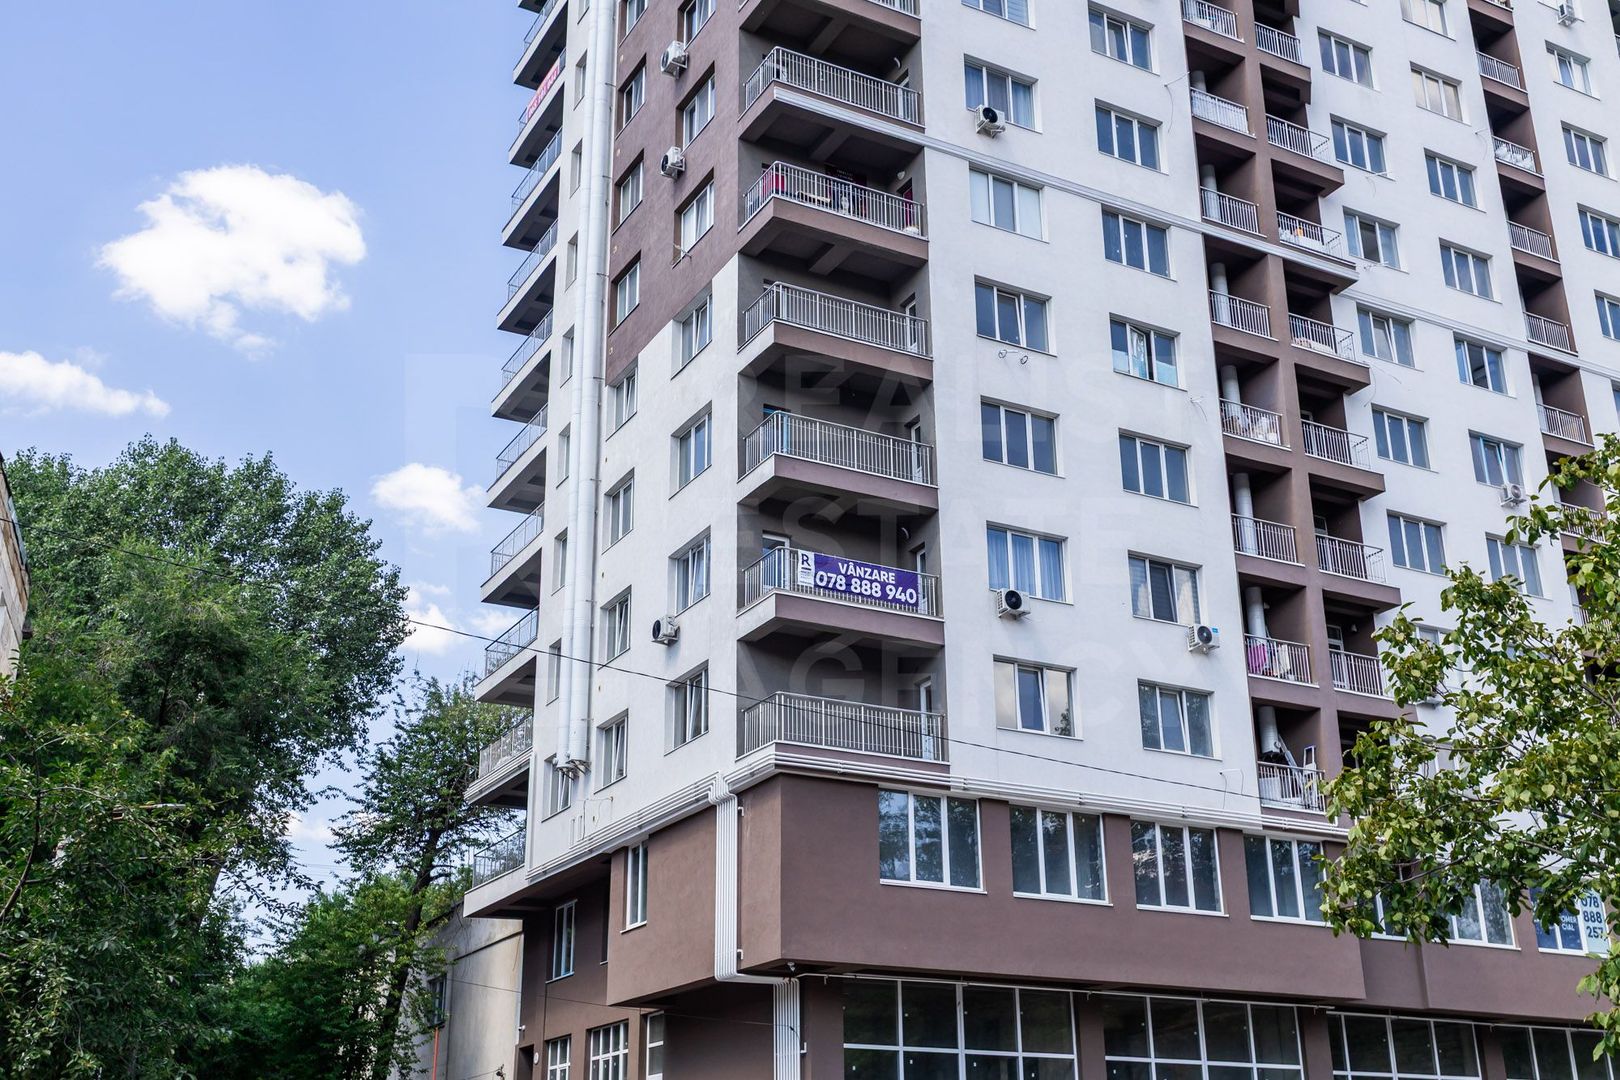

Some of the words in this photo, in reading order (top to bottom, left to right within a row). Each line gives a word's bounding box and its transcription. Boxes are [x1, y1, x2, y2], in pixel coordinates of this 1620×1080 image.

[801, 553, 811, 567] R
[838, 562, 896, 584] VÂNZARE
[815, 571, 847, 591] 078
[850, 578, 882, 598] 888
[885, 585, 917, 604] 940
[1580, 895, 1600, 908] 078
[1583, 910, 1602, 923] 888
[1586, 925, 1604, 939] 257
